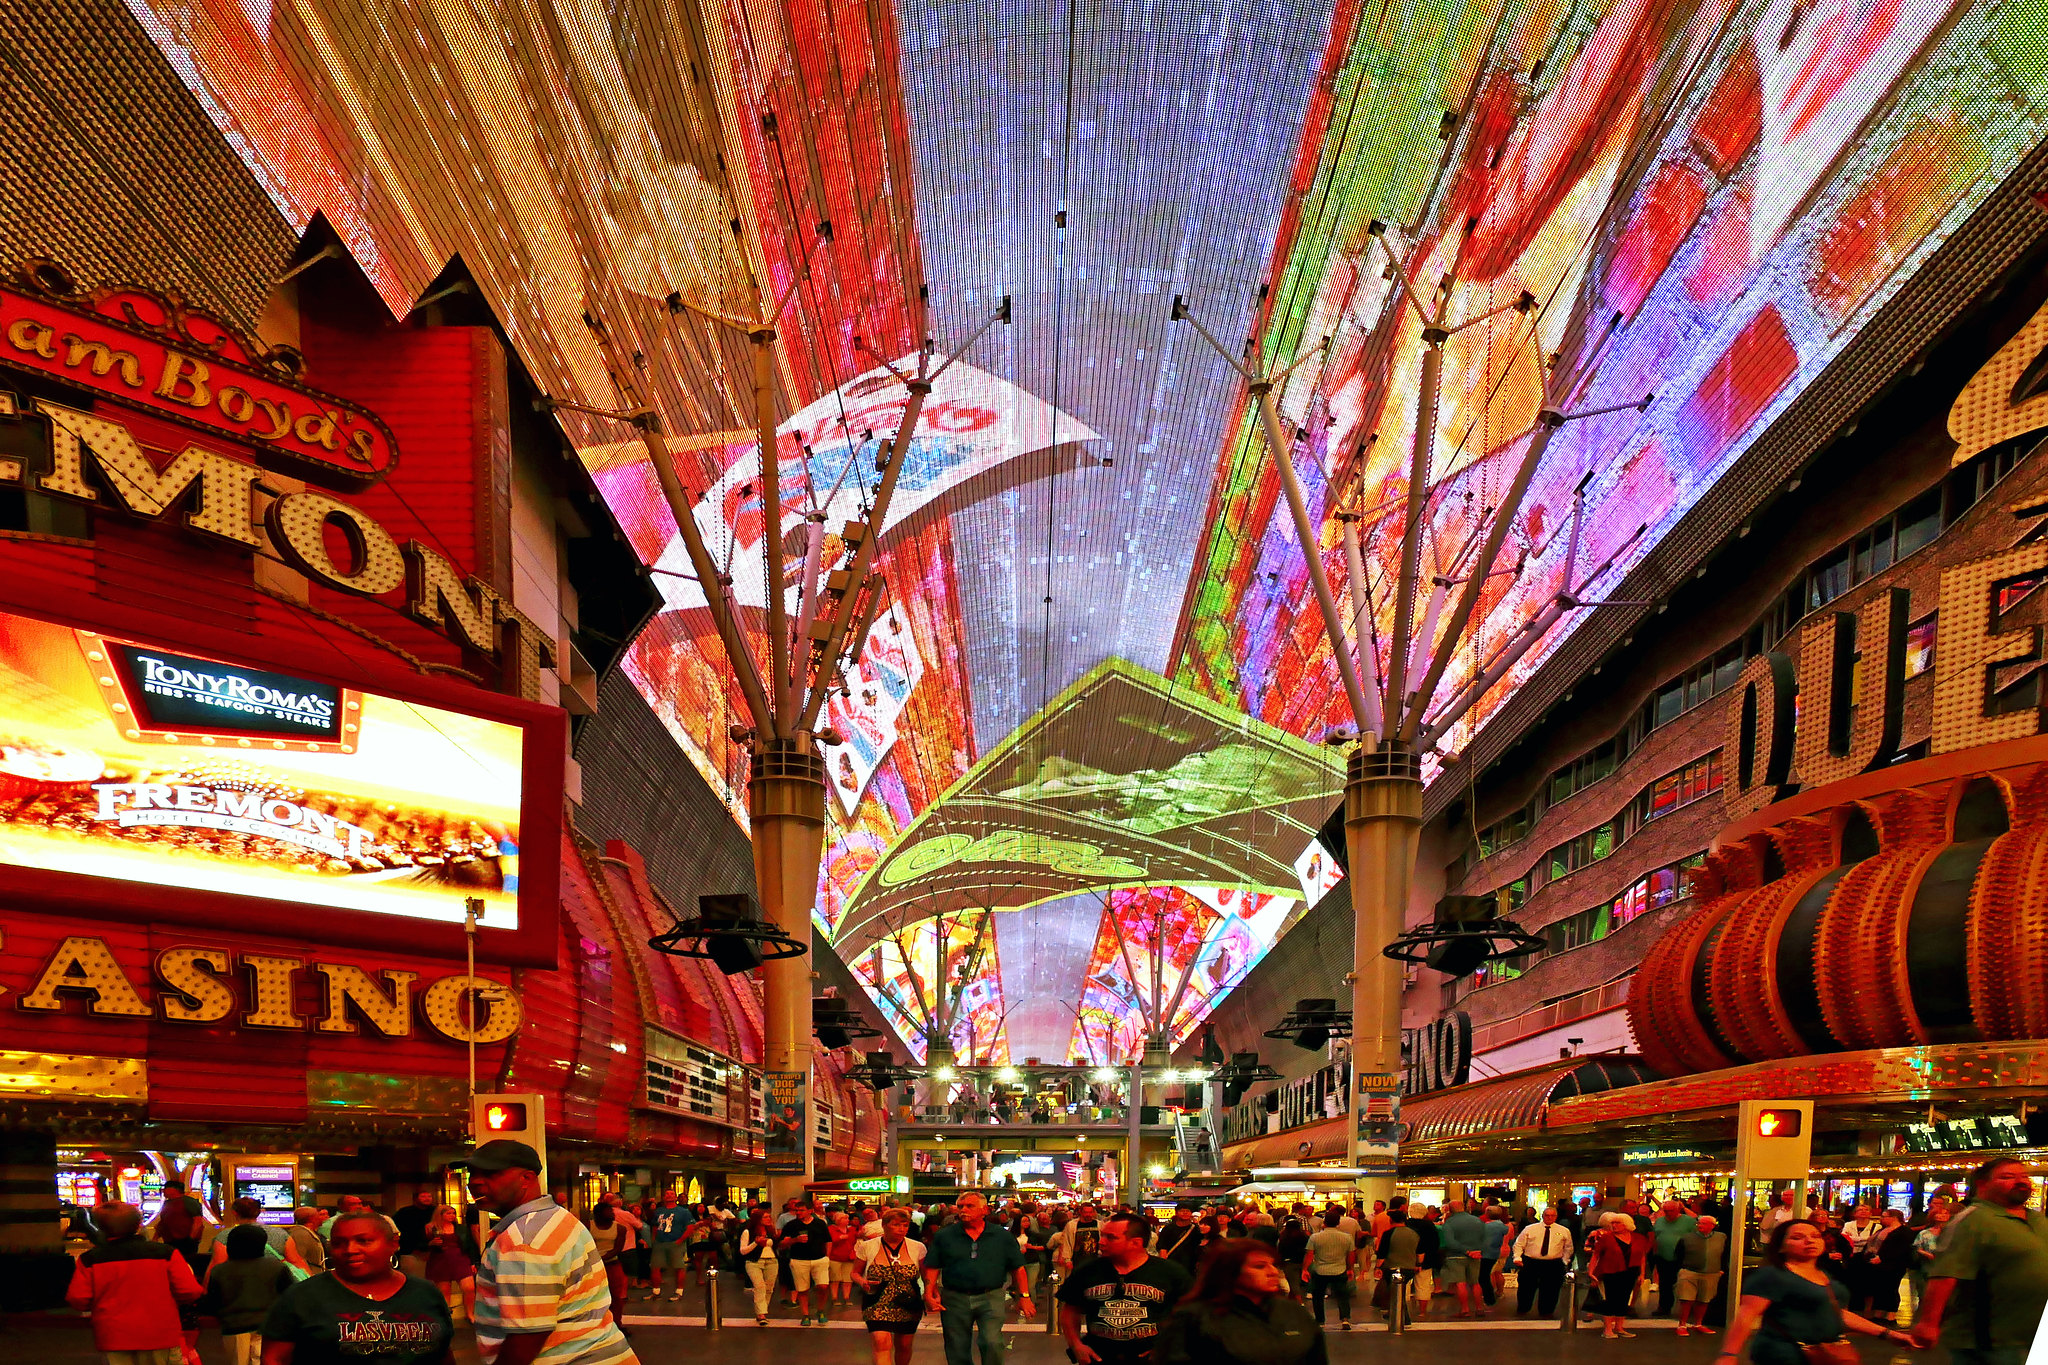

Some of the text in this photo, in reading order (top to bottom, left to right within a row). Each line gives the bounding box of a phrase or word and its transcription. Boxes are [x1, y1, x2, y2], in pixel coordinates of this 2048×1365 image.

[153, 349, 375, 463] Boyd's
[0, 392, 558, 704] MONT
[137, 656, 332, 717] TONY ROMA'S
[145, 683, 331, 729] RIBS SEAFOOD STEAKS
[91, 783, 375, 861] FREMONT
[136, 812, 328, 850] HOTEL & CASINO
[0, 926, 524, 1044] ASINO
[772, 1088, 798, 1097] DARE
[774, 1079, 795, 1088] DOG
[775, 1096, 795, 1105] YOU
[1362, 1076, 1397, 1087] NOW
[850, 1181, 889, 1190] CIGARS
[1662, 1177, 1700, 1191] KING
